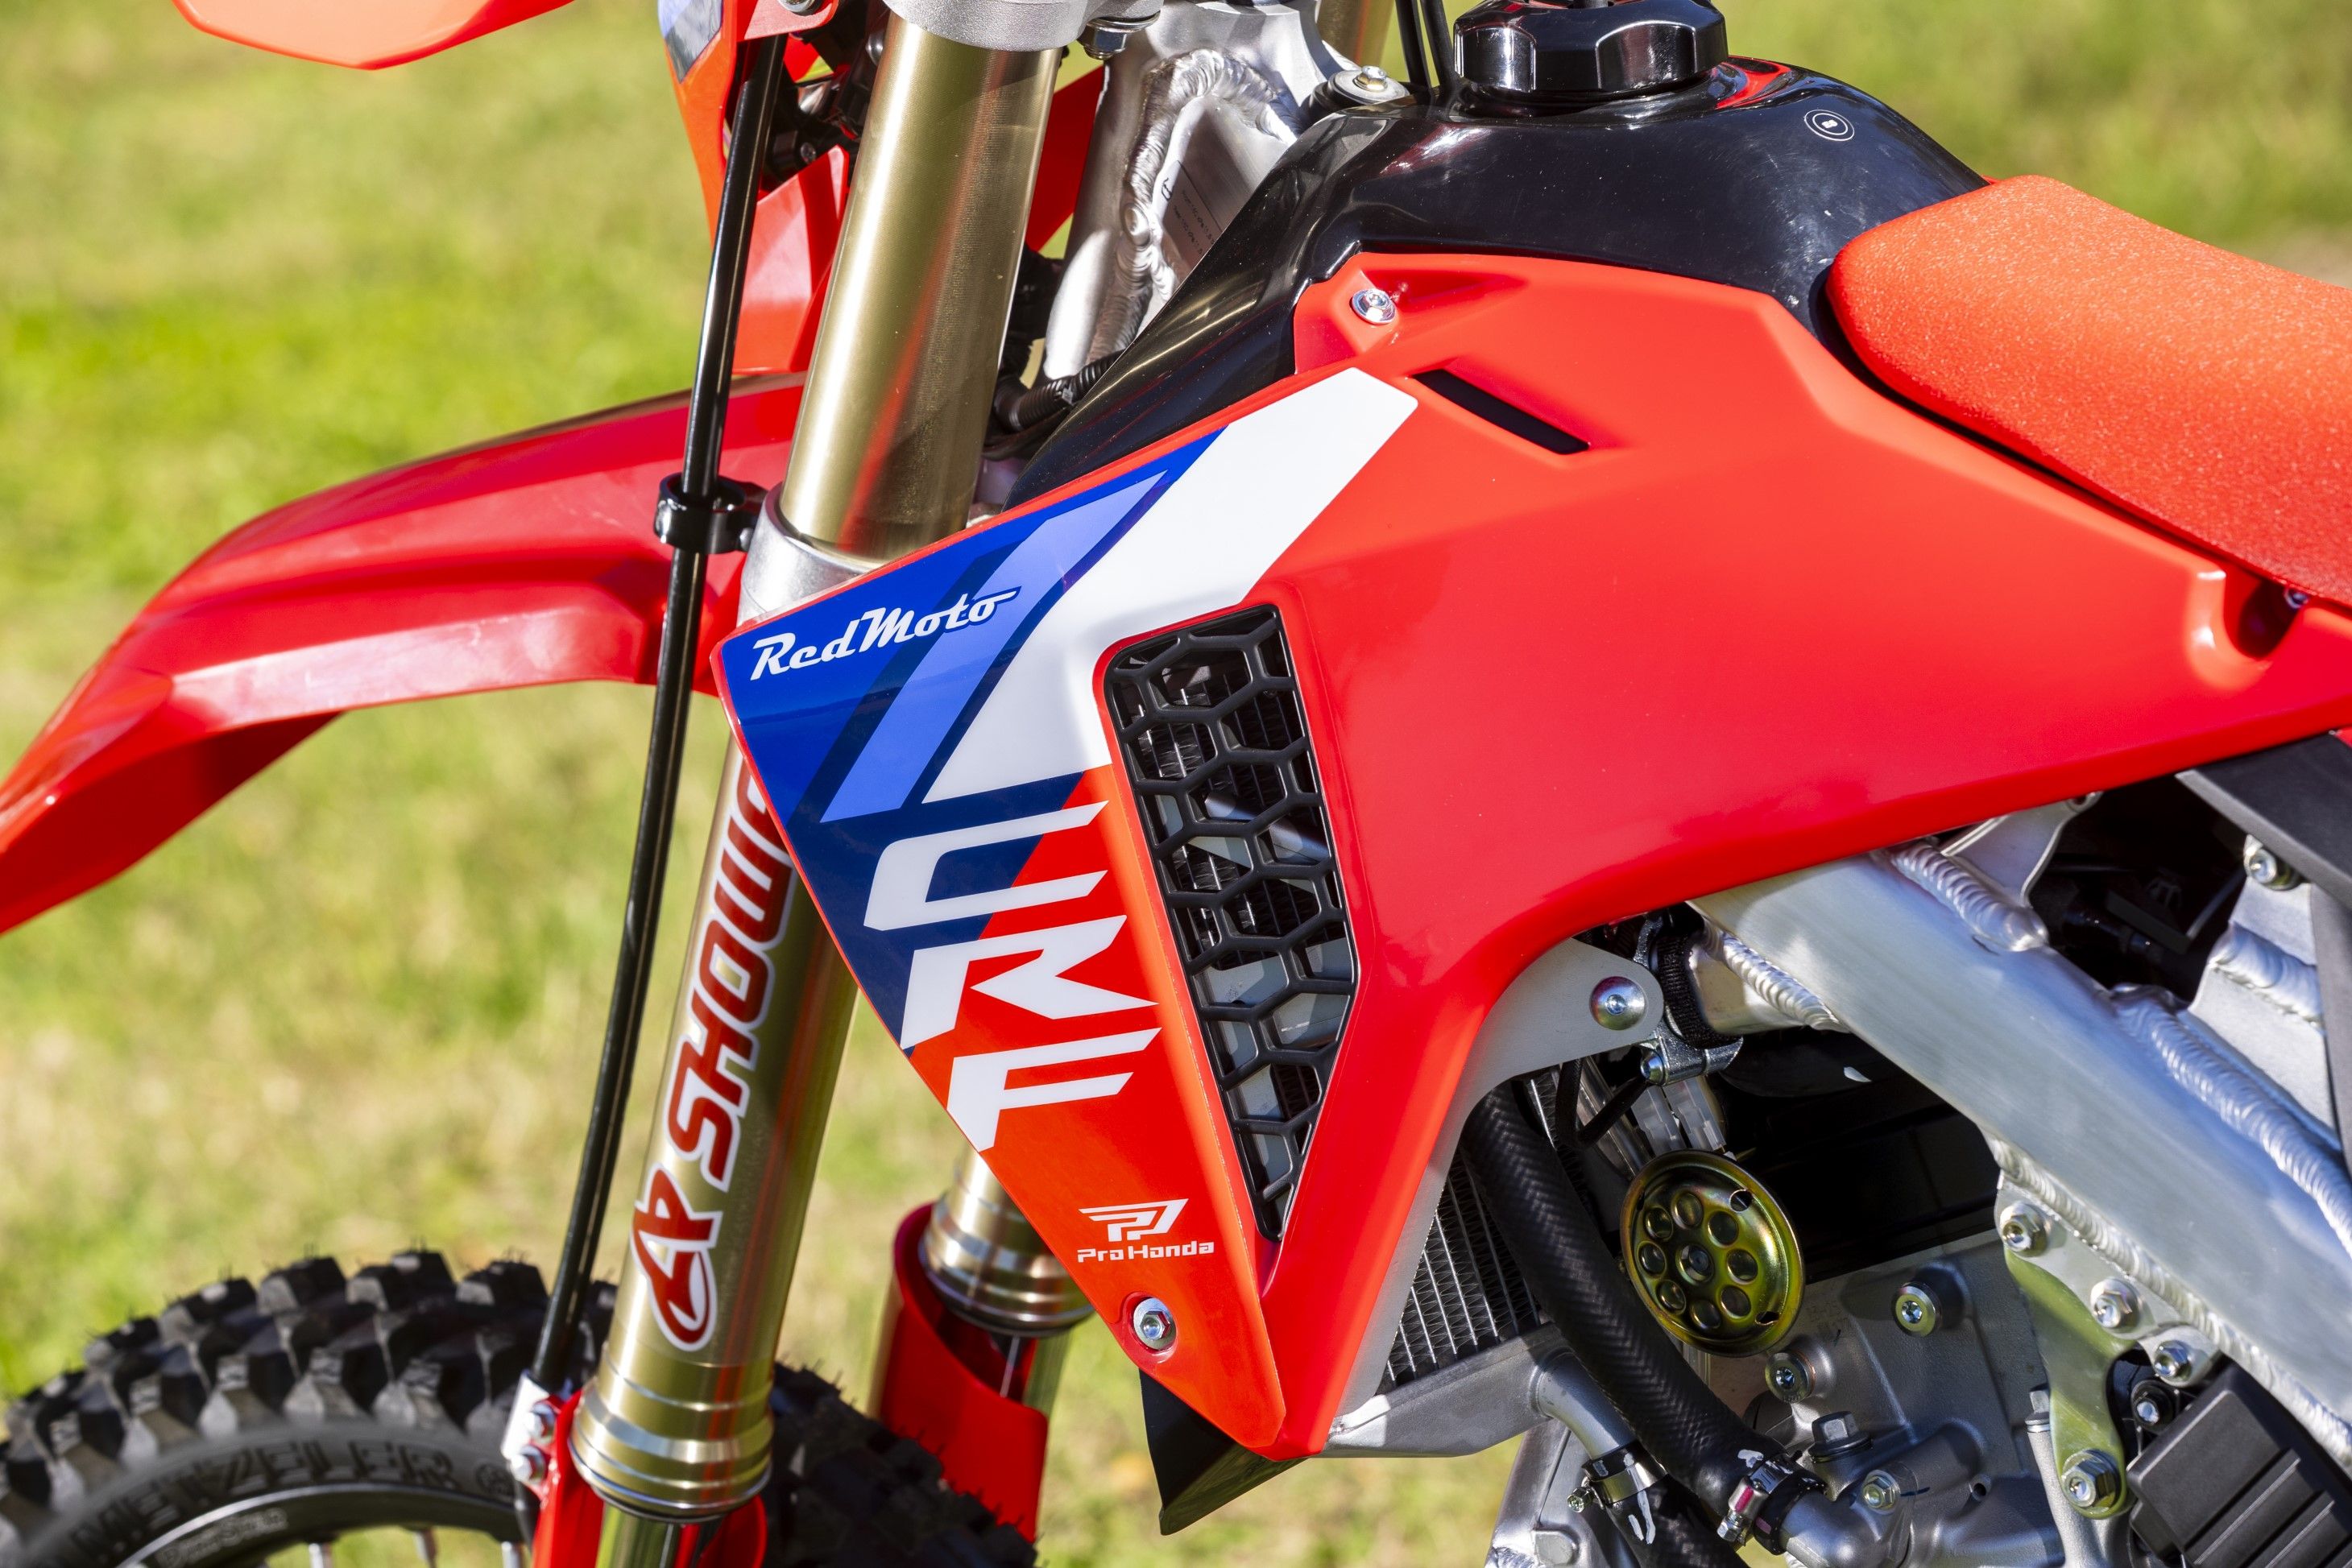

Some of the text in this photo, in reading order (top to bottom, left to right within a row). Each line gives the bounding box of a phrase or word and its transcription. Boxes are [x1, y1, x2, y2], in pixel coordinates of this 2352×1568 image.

[750, 590, 1019, 681] RedMoto
[863, 800, 1162, 1152] CRF
[69, 1440, 461, 1561] METZELER
